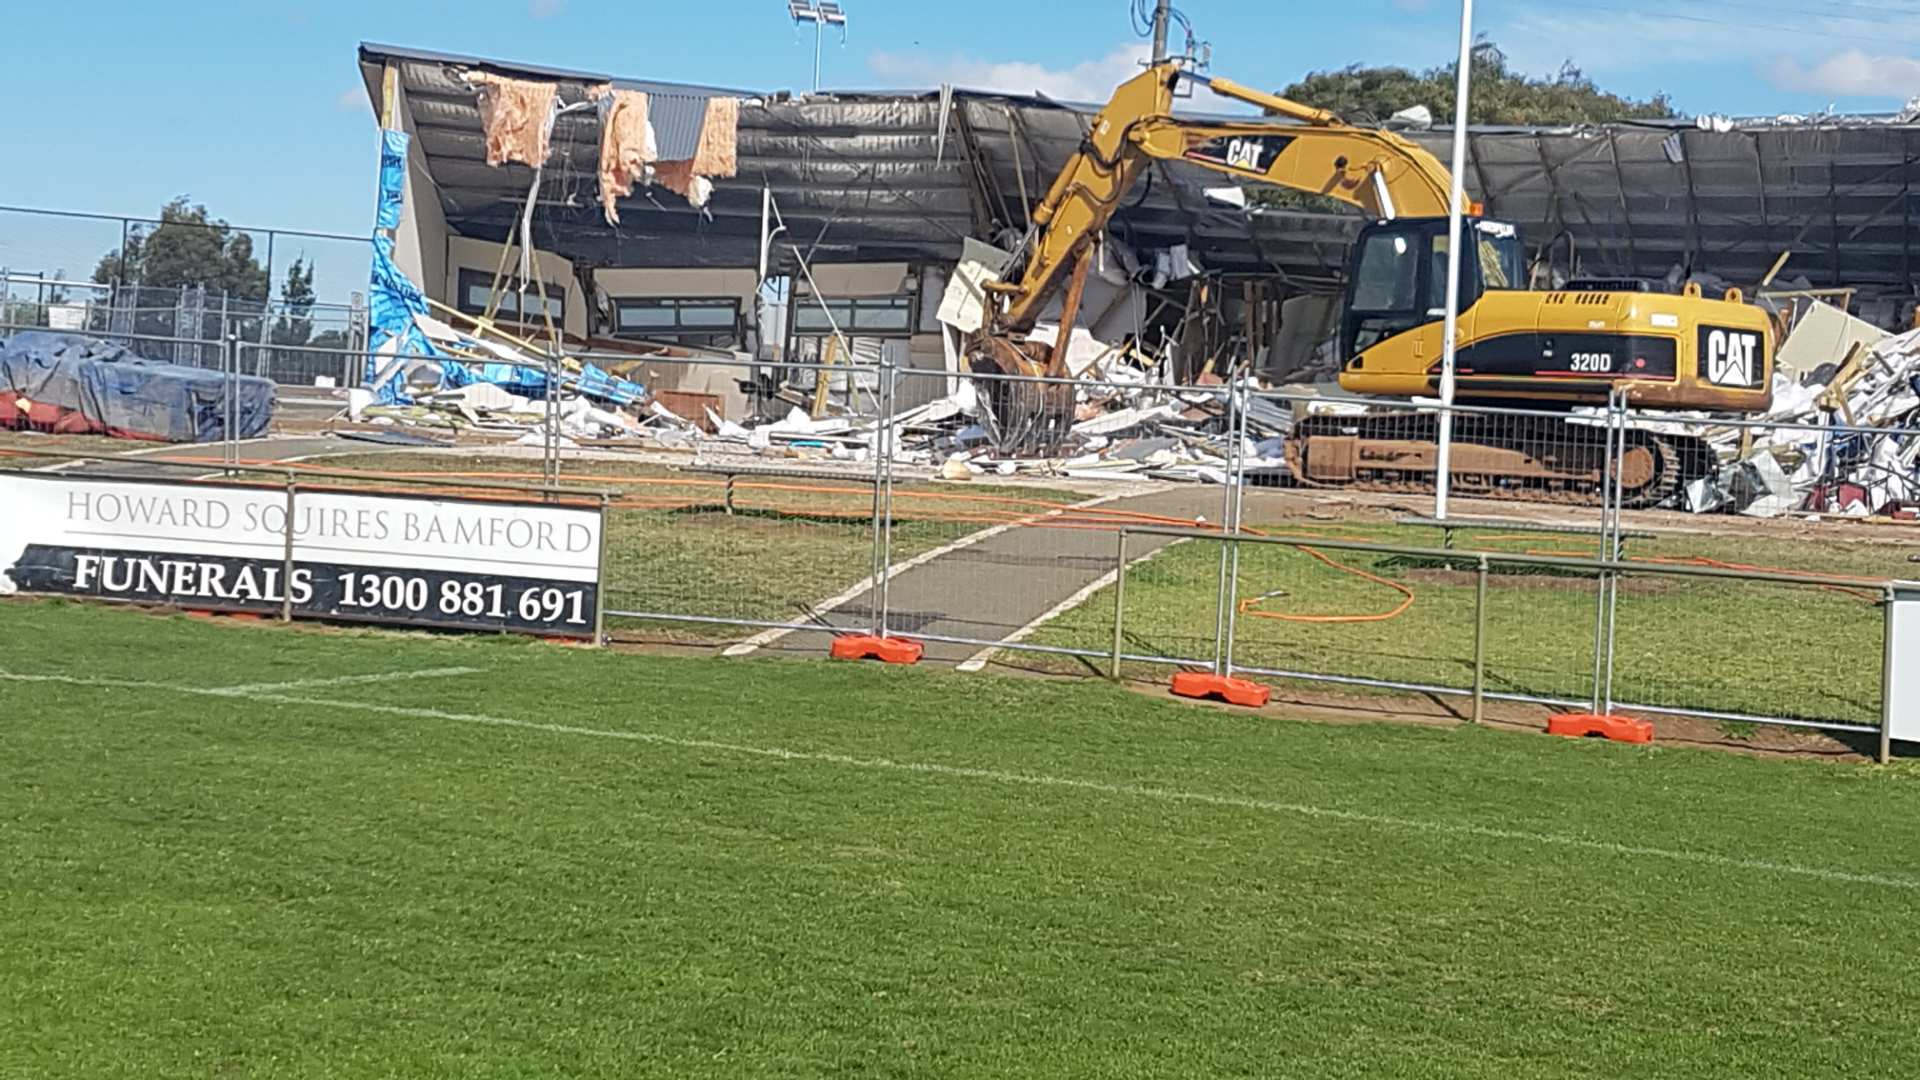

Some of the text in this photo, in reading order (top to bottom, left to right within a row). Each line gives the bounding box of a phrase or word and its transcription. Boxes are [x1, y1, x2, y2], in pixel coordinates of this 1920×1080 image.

[1226, 139, 1264, 170] CAT
[1570, 353, 1612, 372] 320D
[1707, 329, 1756, 386] CAT
[67, 491, 592, 552] HOWARD SQUIRES BAMFORD
[72, 554, 587, 624] FUNERALS 1300 881 691
